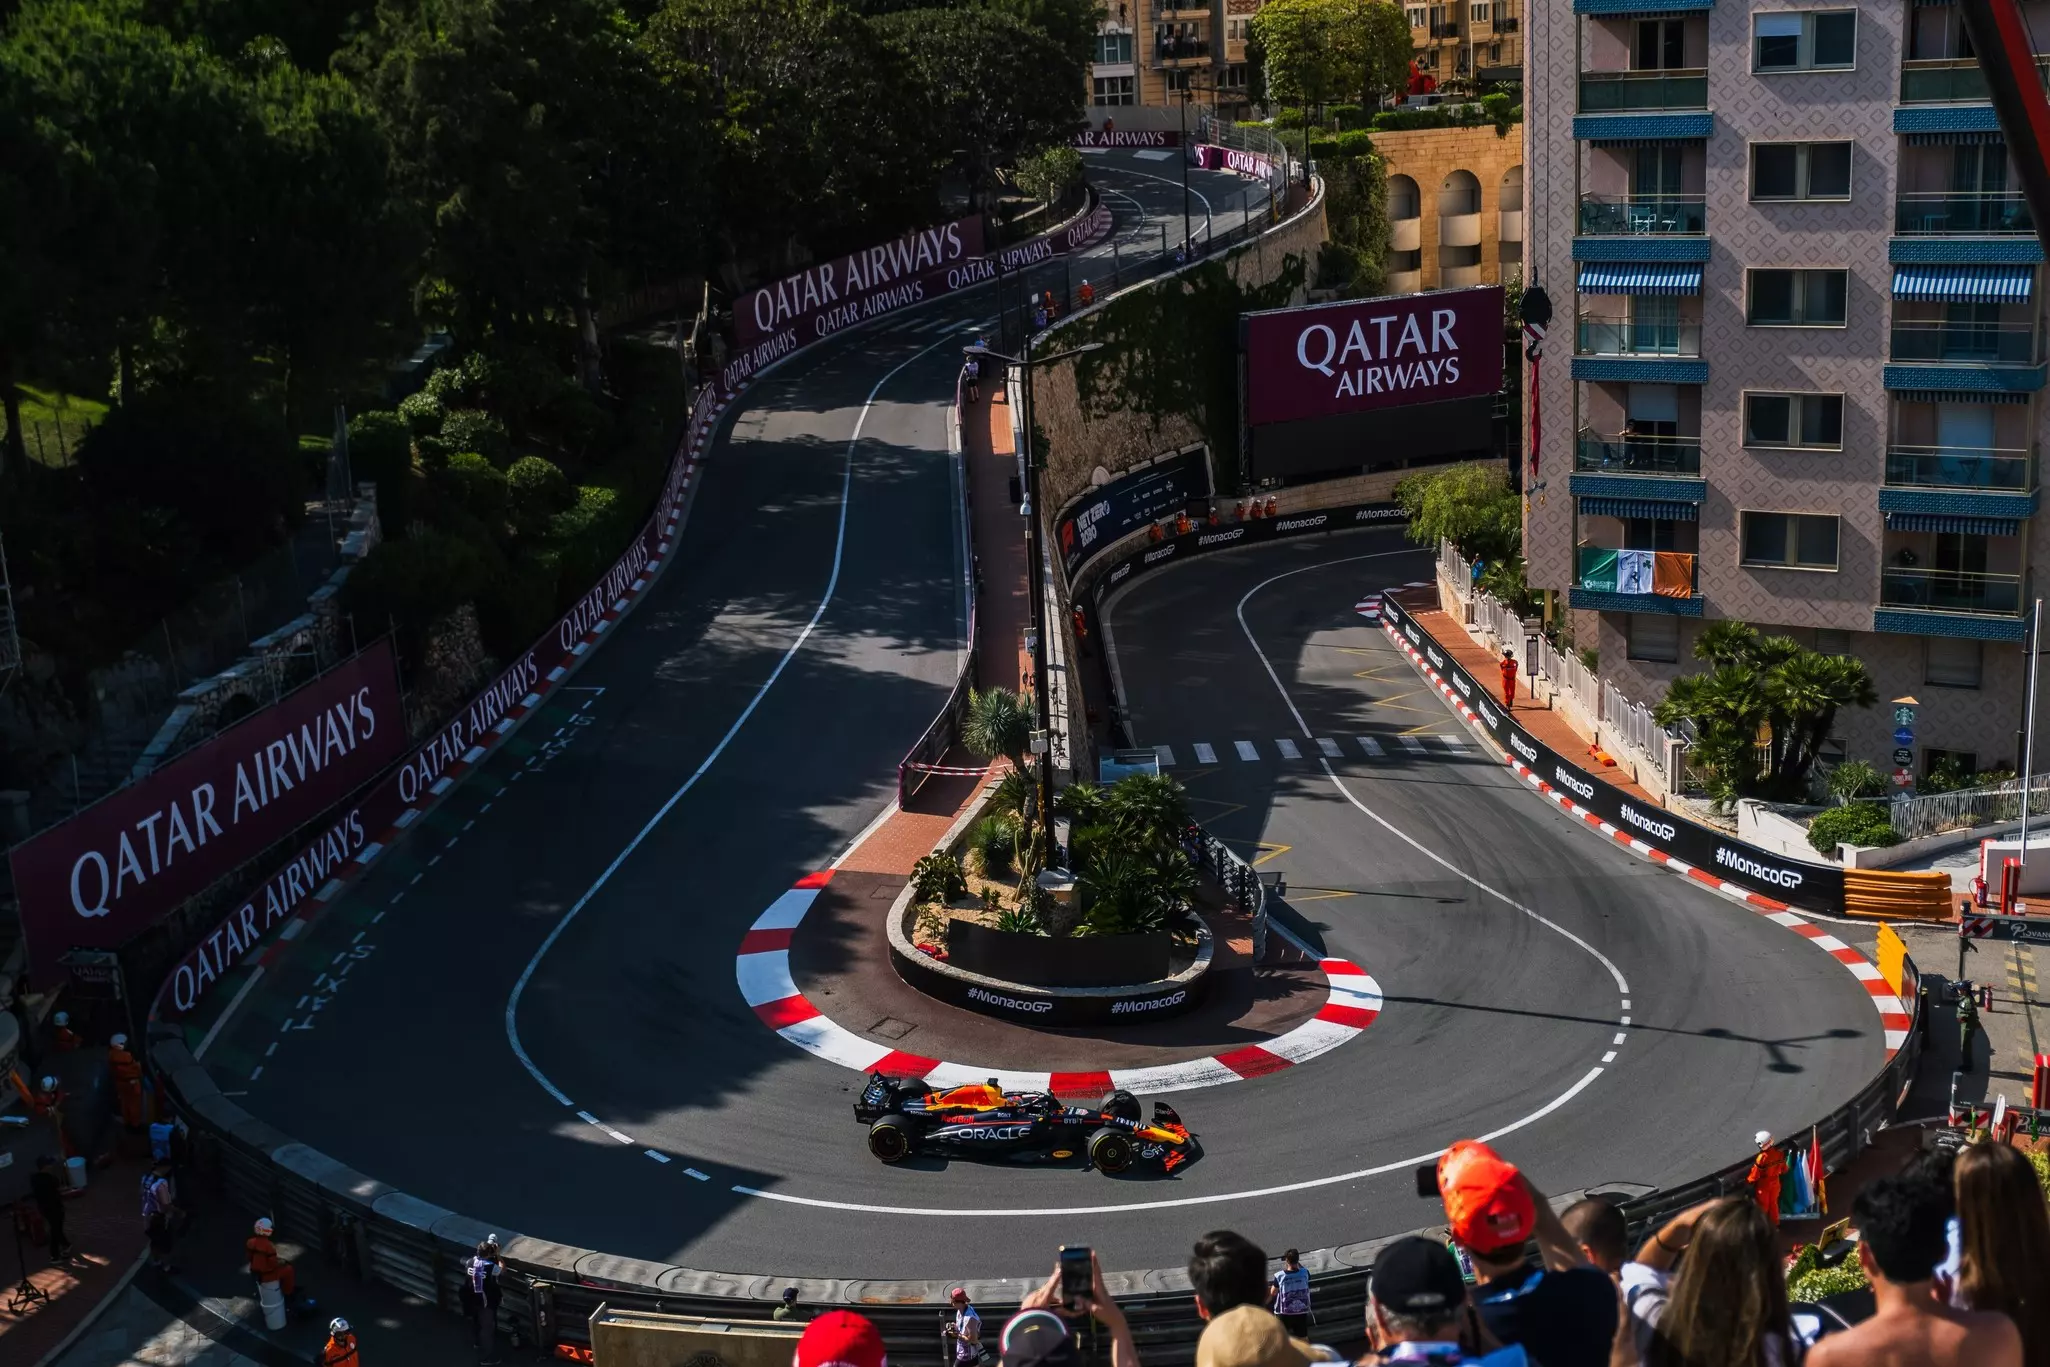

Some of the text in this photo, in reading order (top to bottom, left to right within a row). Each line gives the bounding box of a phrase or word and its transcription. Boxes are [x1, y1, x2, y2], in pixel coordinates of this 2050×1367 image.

[1100, 131, 1165, 146] AIRWAYS
[1227, 151, 1254, 173] QATAR
[754, 222, 961, 332] QATAR AIRWAYS
[948, 260, 995, 289] QATAR
[815, 281, 923, 336] QATAR AIRWAYS
[723, 328, 797, 391] QATAR AIRWAYS
[1297, 308, 1459, 378] QATAR
[1335, 356, 1460, 399] AIRWAYS
[1077, 510, 1091, 533] NET
[1090, 500, 1111, 524] ZERO
[1276, 515, 1327, 532] #MonacoGP
[1144, 544, 1175, 564] #MonacoGP
[1197, 529, 1244, 546] #MonacoGP
[560, 535, 649, 651] QATAR AIRWAYS
[398, 651, 538, 803] QATAR AIRWAYS
[1510, 732, 1537, 763] #MonacoGP
[1555, 765, 1594, 800] #MonacoGP
[70, 685, 376, 919] QATAR AIRWAYS
[1620, 803, 1675, 842] #MonacoGP
[1716, 846, 1803, 889] #MonacoGP
[173, 809, 365, 1013] QATAR AIRWAYS
[291, 945, 377, 1030] TAXIS
[967, 987, 1053, 1014] #MonacoGP
[1111, 990, 1186, 1014] #MonacoGP
[958, 1127, 1030, 1140] ORACLE
